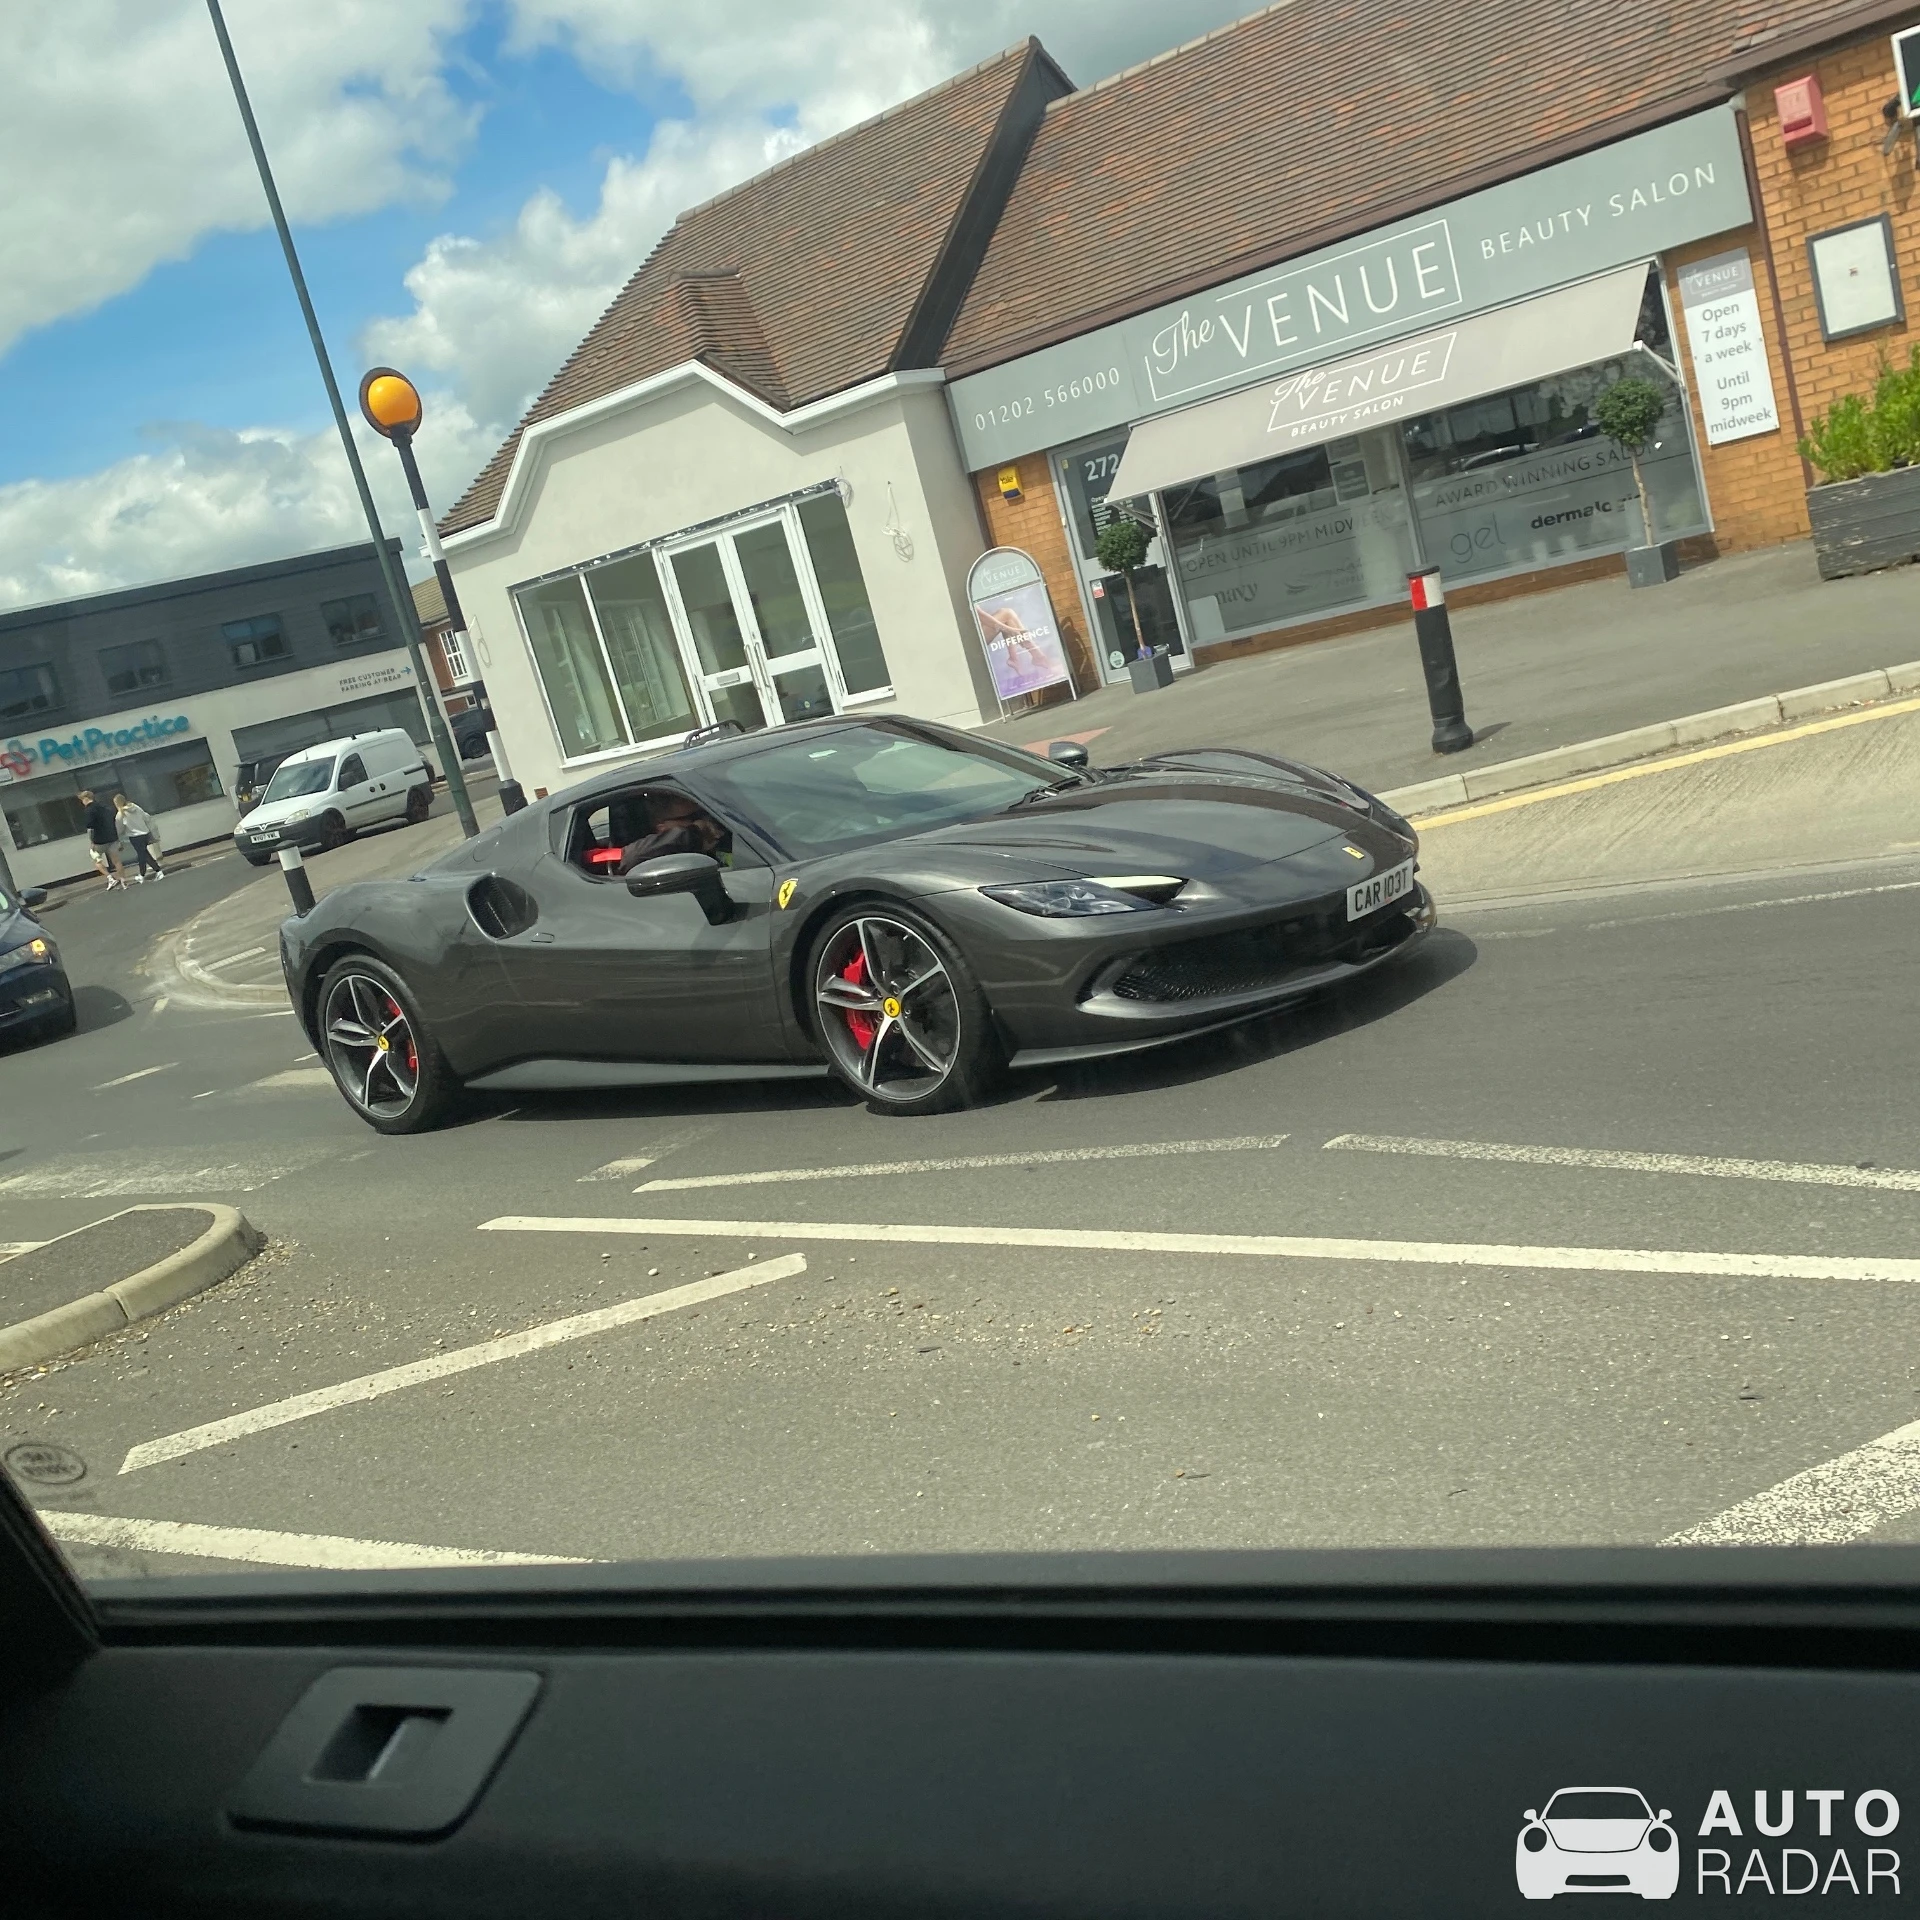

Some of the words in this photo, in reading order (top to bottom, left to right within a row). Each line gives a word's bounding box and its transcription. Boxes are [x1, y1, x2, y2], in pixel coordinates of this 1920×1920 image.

[1481, 204, 1591, 260] BEAUTY
[1609, 162, 1716, 217] SALON
[1694, 266, 1739, 288] VENUE
[1152, 310, 1215, 375] The
[1219, 241, 1446, 358] VENUE
[1702, 303, 1740, 323] Open
[1702, 330, 1711, 343] 7
[1715, 321, 1747, 341] days
[1705, 352, 1713, 363] a
[1716, 340, 1752, 360] week
[1270, 369, 1327, 405] The
[1298, 350, 1431, 411] VENUE
[1717, 370, 1750, 390] Until
[975, 397, 1035, 431] 01202
[1044, 367, 1120, 407] 566000
[1721, 393, 1753, 412] 9pm
[1291, 413, 1348, 438] BEAUTY
[1352, 396, 1404, 420] SALON
[1710, 407, 1772, 433] midweek
[1084, 453, 1119, 481] 272
[1435, 479, 1499, 508] AWARD
[1502, 456, 1590, 488] WINNING
[1186, 553, 1228, 573] OPEN
[1231, 541, 1277, 562] UNTIL
[1279, 529, 1310, 549] 9PM
[1451, 511, 1507, 565] gel
[986, 565, 1020, 583] VENUE
[1215, 583, 1258, 605] navy
[990, 625, 1051, 653] DIFFERENCE
[340, 677, 356, 686] FREE
[358, 668, 395, 681] CUSTOMER
[341, 681, 372, 693] PARKING
[383, 673, 402, 683] REAR
[1355, 881, 1381, 913] CAR
